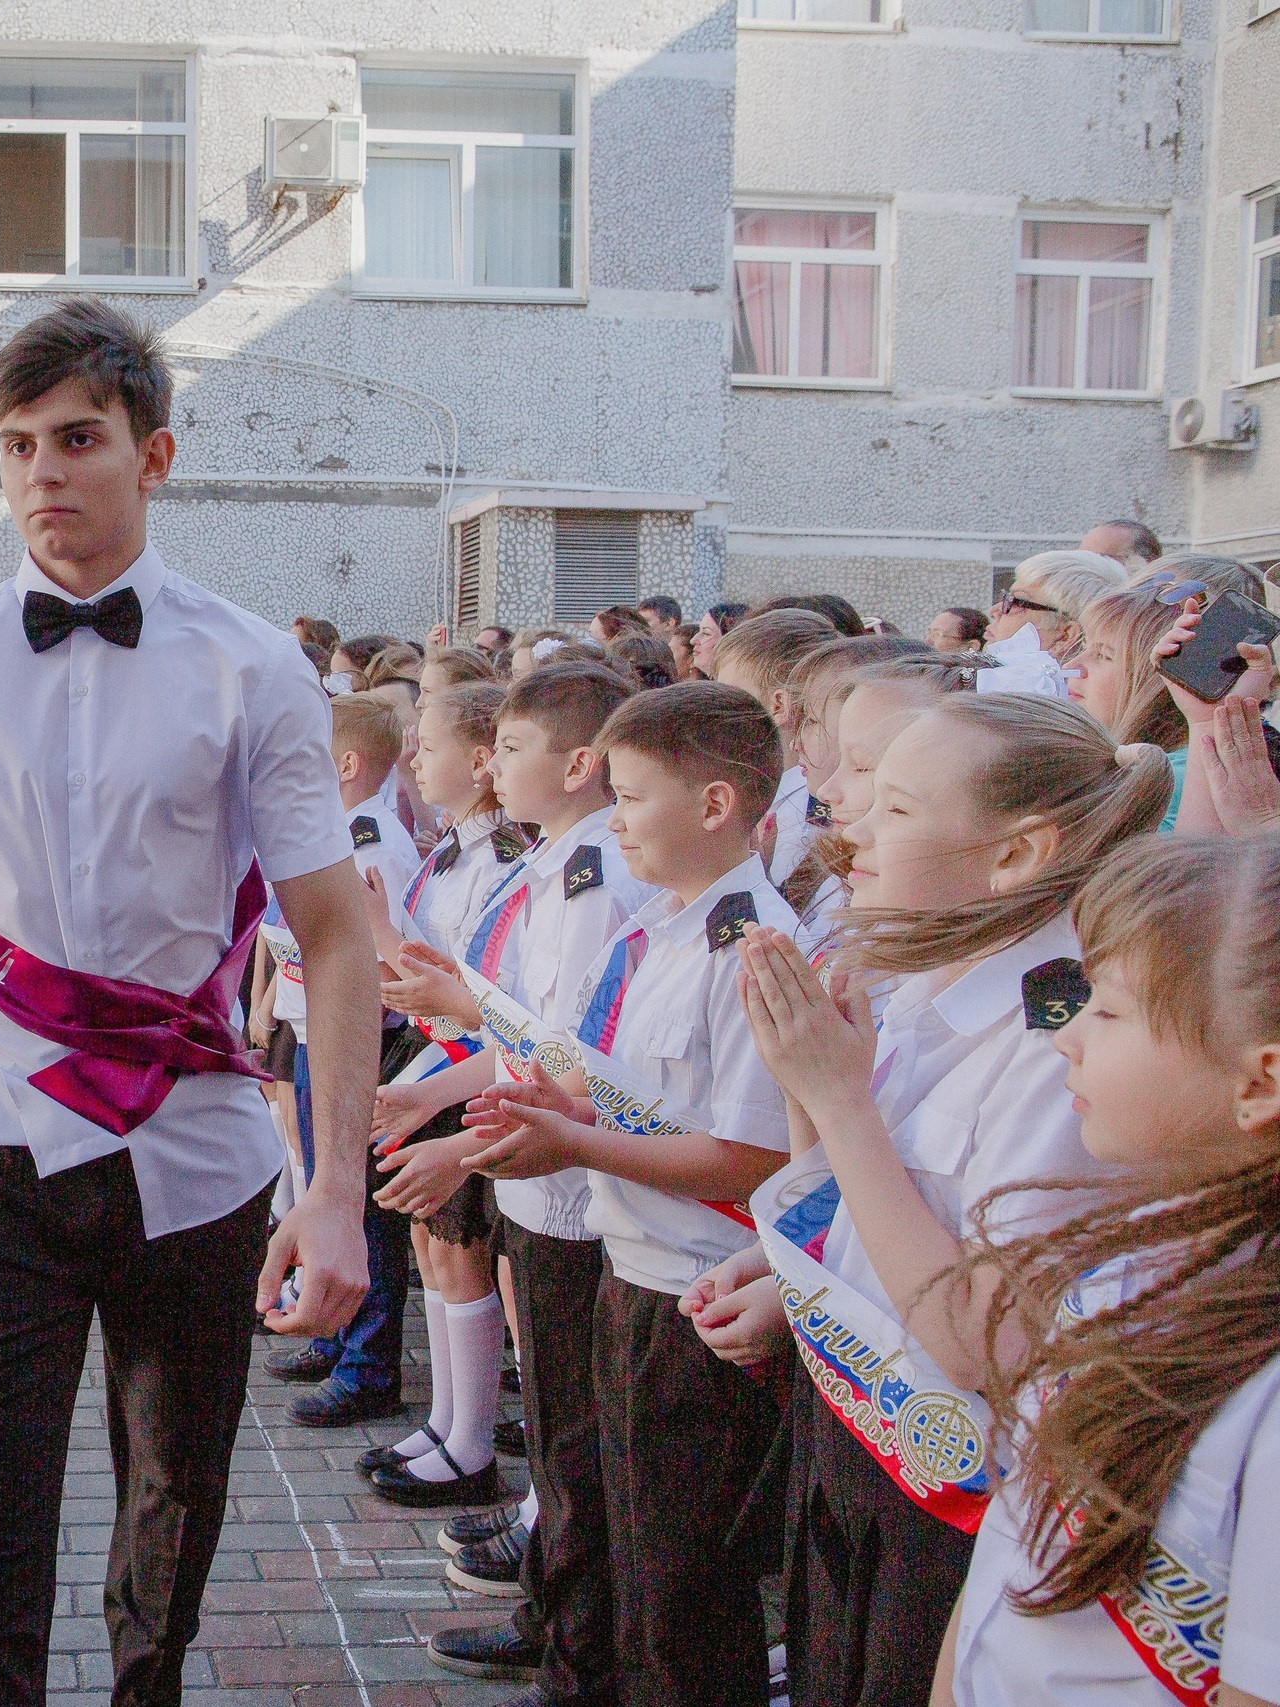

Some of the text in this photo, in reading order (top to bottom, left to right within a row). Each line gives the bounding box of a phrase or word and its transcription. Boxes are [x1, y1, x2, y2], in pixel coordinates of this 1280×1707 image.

[355, 831, 373, 843] 33
[569, 867, 593, 889] 33
[718, 917, 746, 942] 33
